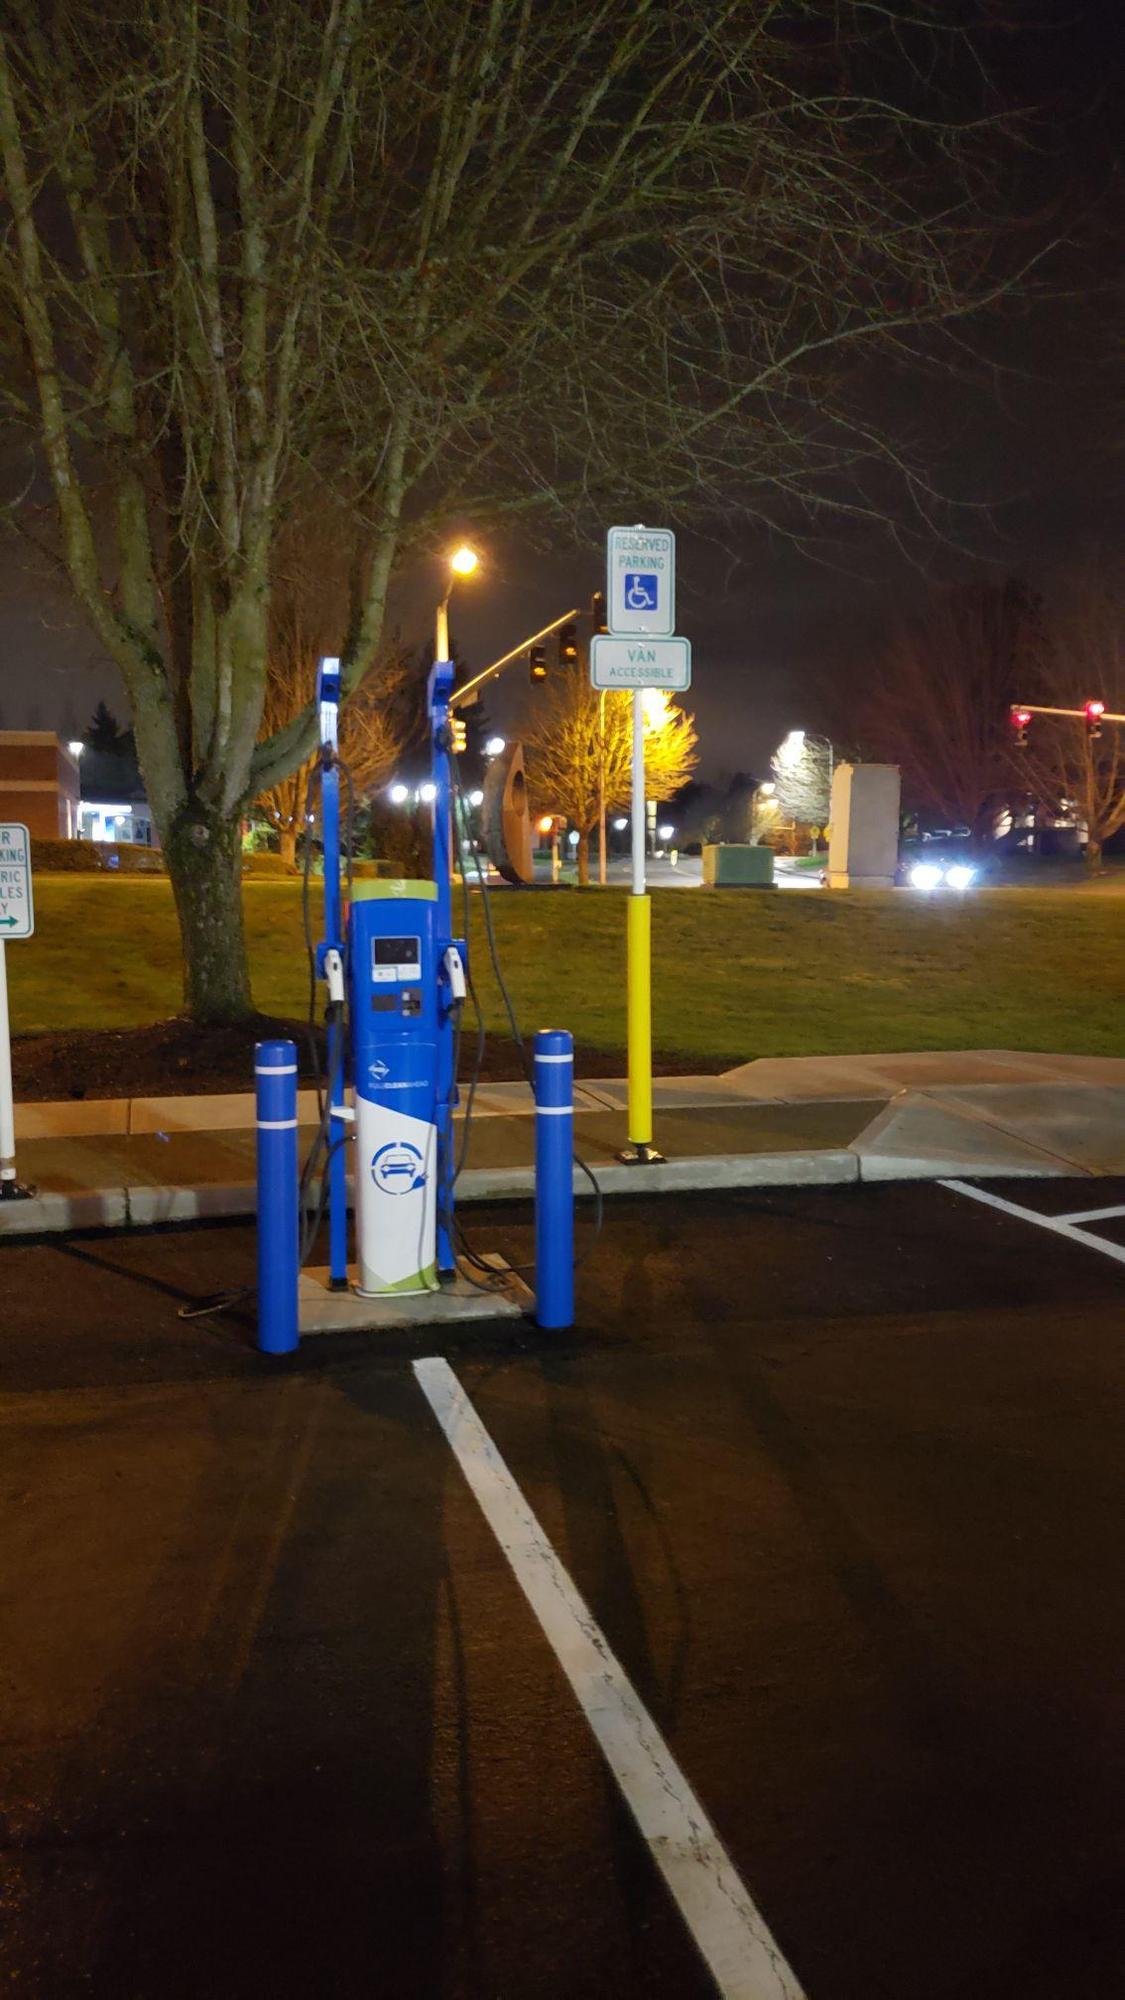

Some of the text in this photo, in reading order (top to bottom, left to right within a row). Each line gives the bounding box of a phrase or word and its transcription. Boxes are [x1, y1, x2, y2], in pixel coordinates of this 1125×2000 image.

[615, 536, 669, 552] RESERVED
[619, 554, 665, 570] PARKING
[627, 649, 656, 663] VAN
[609, 667, 674, 679] ACCESSIBLE
